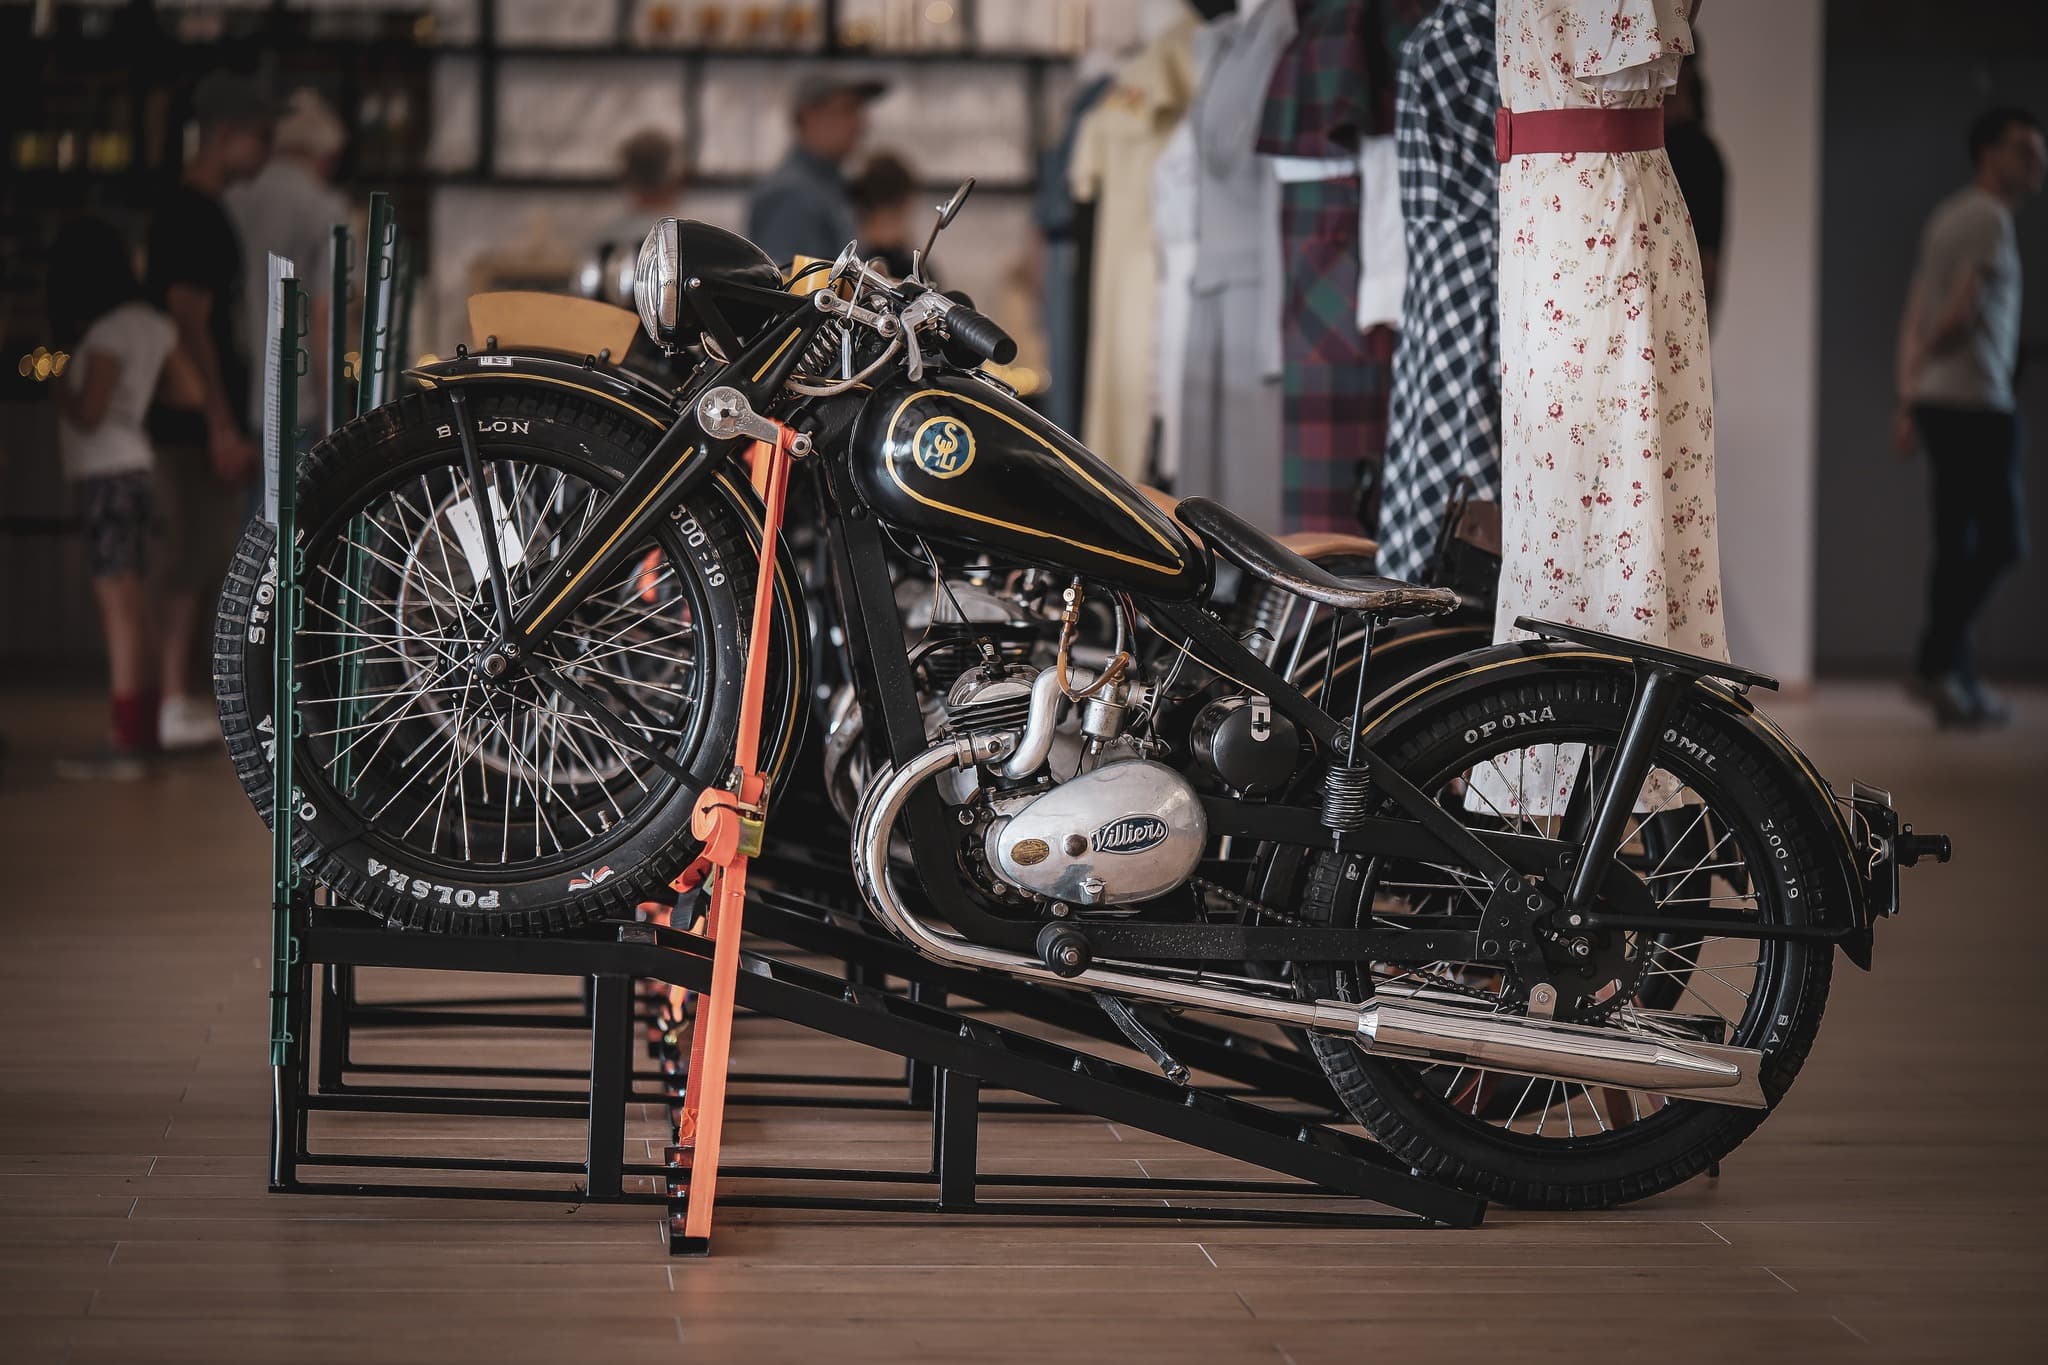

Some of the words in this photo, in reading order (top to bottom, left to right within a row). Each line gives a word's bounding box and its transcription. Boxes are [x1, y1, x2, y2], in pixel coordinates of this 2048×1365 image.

[436, 420, 530, 439] BLON
[1464, 705, 1556, 744] OPONA
[1663, 728, 1717, 772] OMIL
[1091, 819, 1165, 852] Villiers
[367, 857, 501, 909] POLSKA
